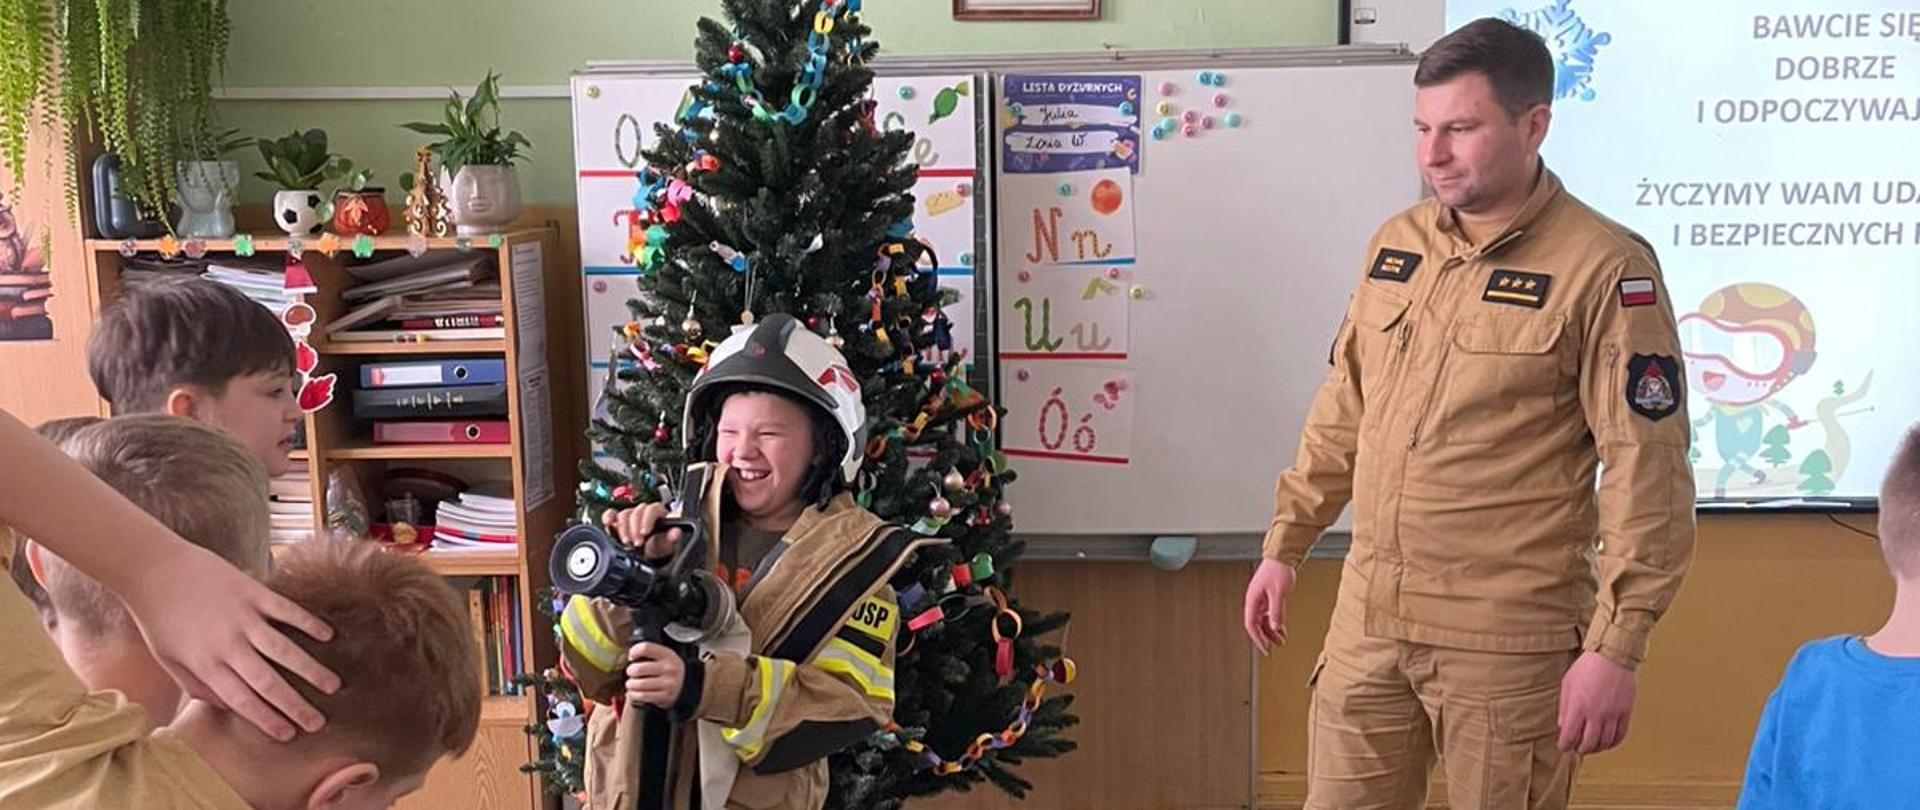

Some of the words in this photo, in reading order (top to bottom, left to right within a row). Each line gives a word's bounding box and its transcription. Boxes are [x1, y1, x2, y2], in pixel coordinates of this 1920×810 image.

[1753, 13, 1871, 39] BAWCIE
[1879, 12, 1920, 42] SIĘ
[1775, 55, 1896, 81] DOBRZE
[1023, 82, 1055, 93] LISTA
[1697, 100, 1704, 124] I
[1636, 177, 1771, 206] ŻYCZYMY
[1780, 182, 1862, 205] WAM
[1873, 181, 1920, 205] UD
[1026, 206, 1063, 264] N
[1071, 229, 1112, 259] n
[1673, 224, 1680, 246] I
[1690, 222, 1903, 246] BEZPIECZNYCH
[1014, 296, 1064, 352] U
[1070, 322, 1112, 350] u
[1038, 387, 1069, 451] Ó
[1073, 413, 1096, 452] ó
